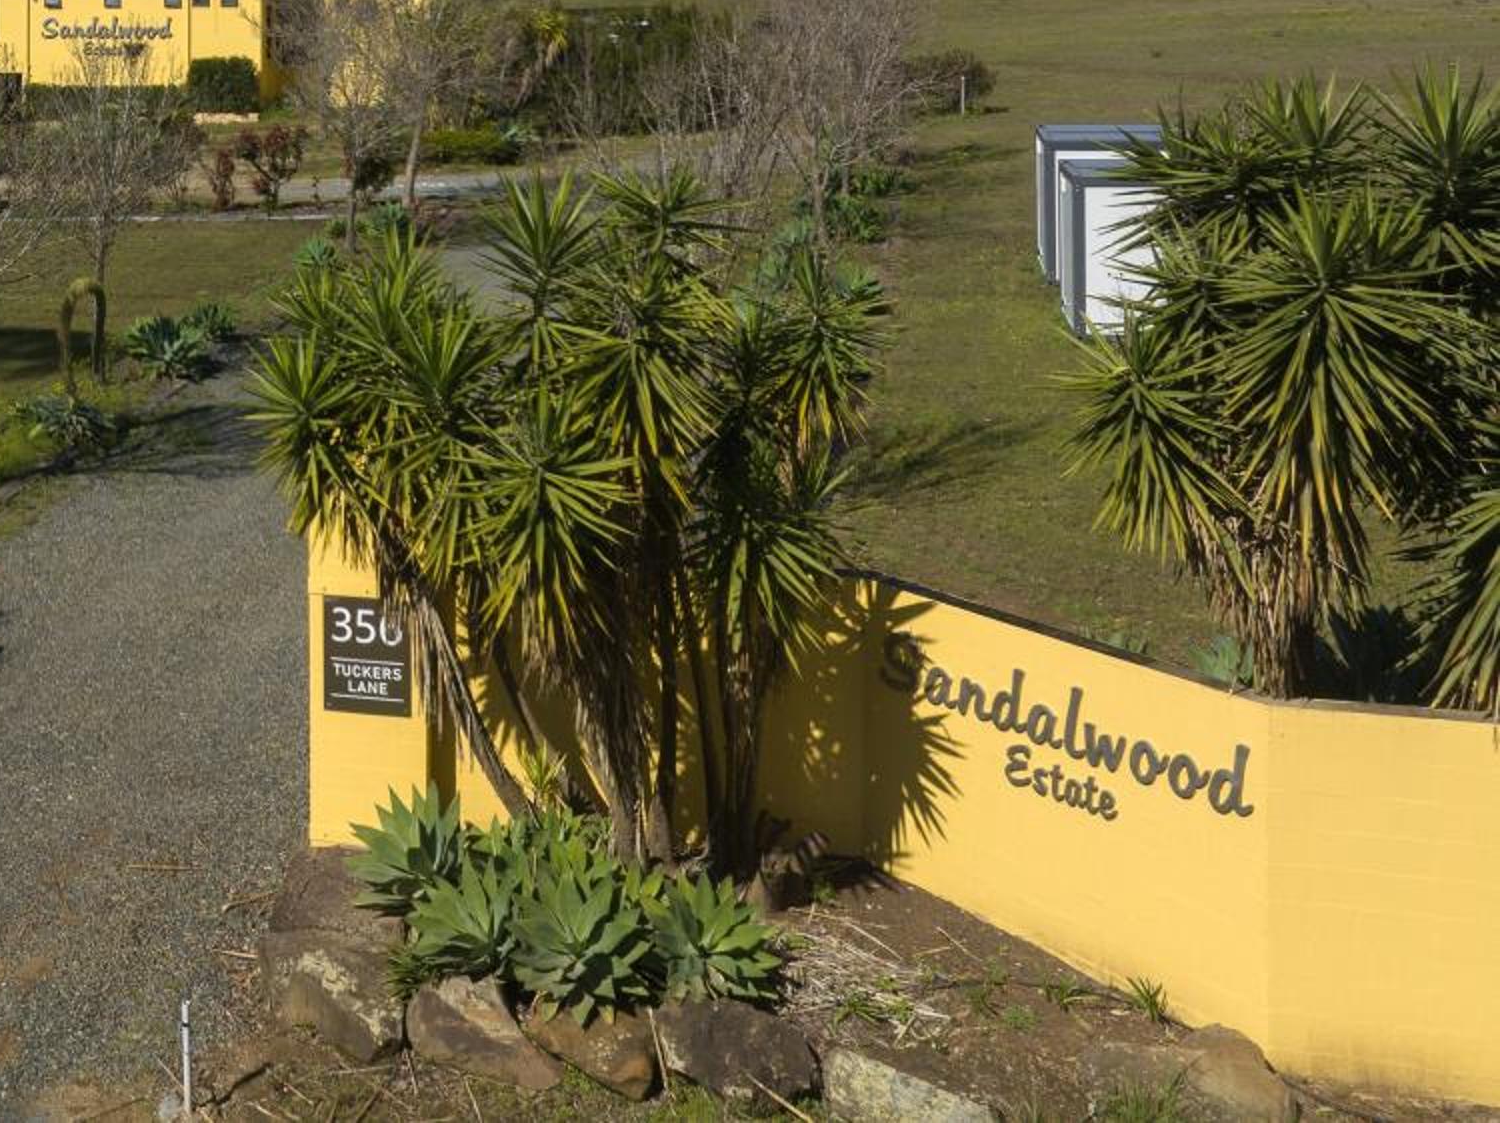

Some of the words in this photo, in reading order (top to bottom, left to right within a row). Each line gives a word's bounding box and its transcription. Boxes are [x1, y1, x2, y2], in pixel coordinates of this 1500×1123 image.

[41, 16, 173, 40] Sandalwood
[333, 664, 402, 681] TUCKERS
[348, 680, 389, 695] LANE
[880, 630, 1255, 818] Sandalwood
[1004, 744, 1118, 820] Estate
